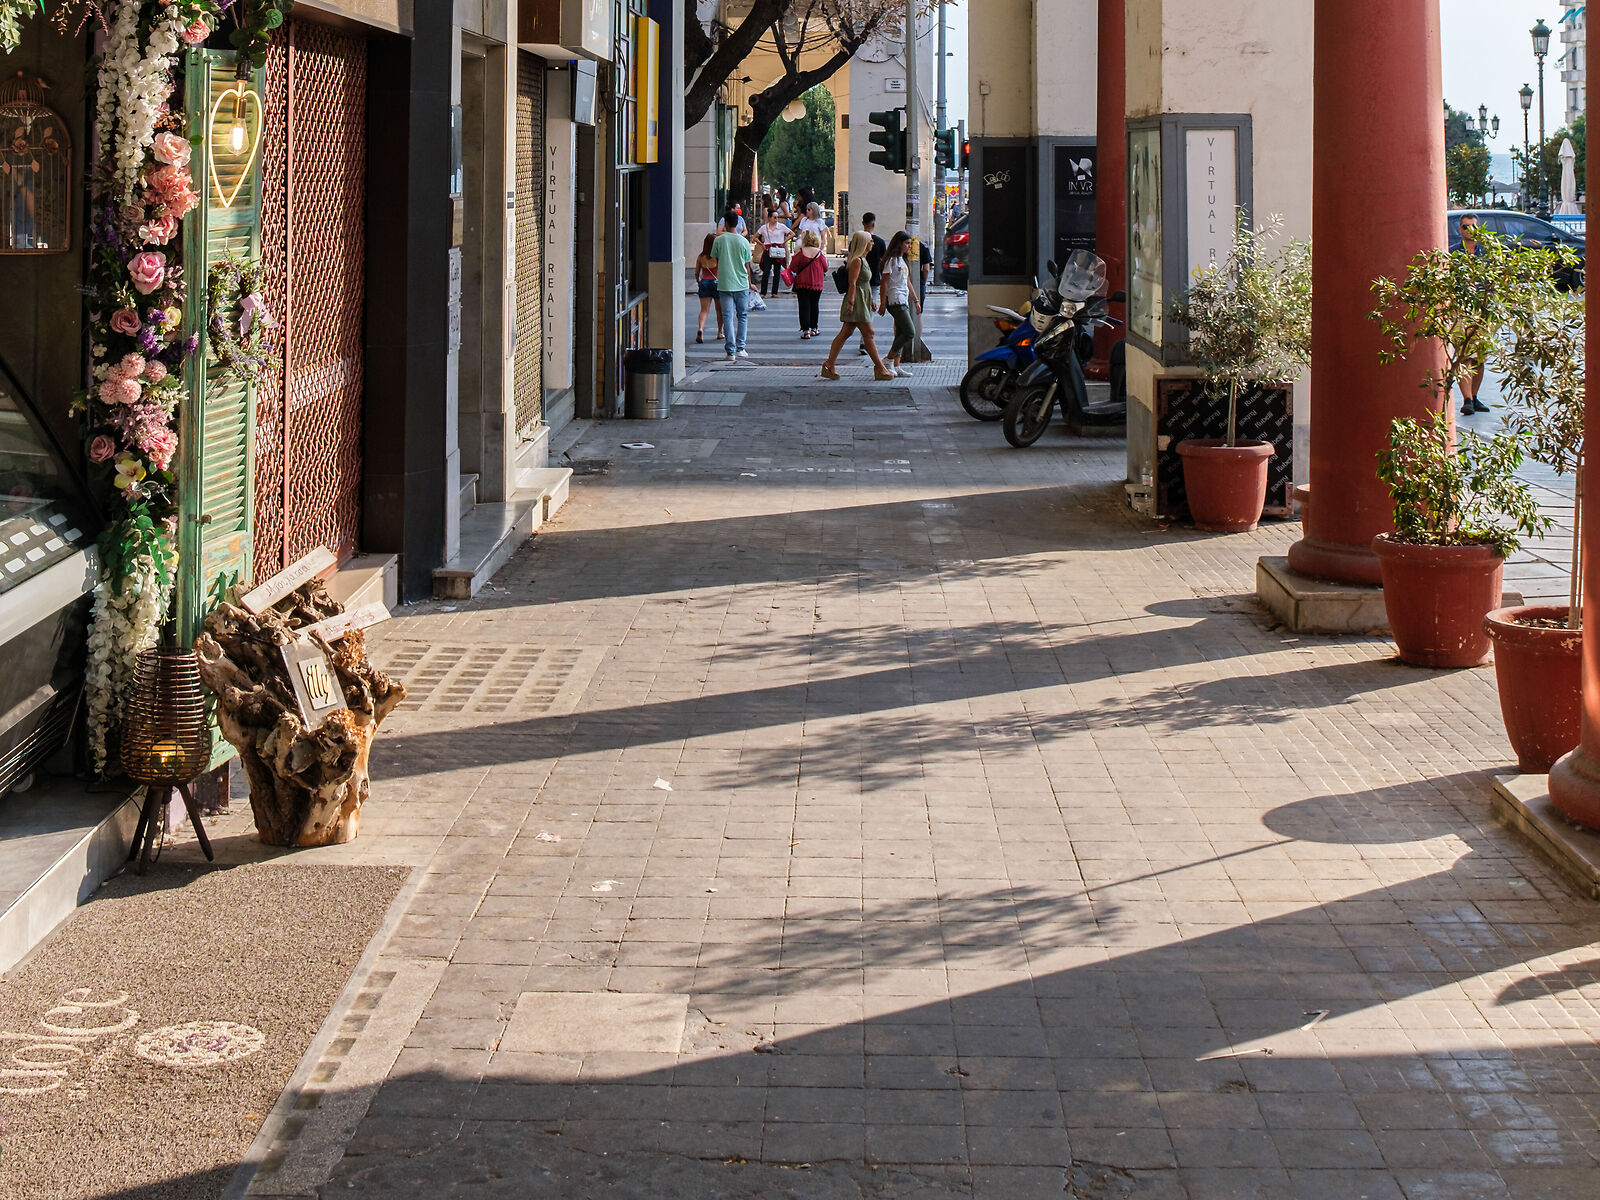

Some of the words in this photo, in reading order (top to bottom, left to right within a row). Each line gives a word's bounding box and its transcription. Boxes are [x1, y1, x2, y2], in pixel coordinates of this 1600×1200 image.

[547, 146, 557, 244] VIRTUAL
[1207, 137, 1217, 234] VIRTUAL
[546, 263, 555, 362] REALITY
[306, 664, 329, 704] illy
